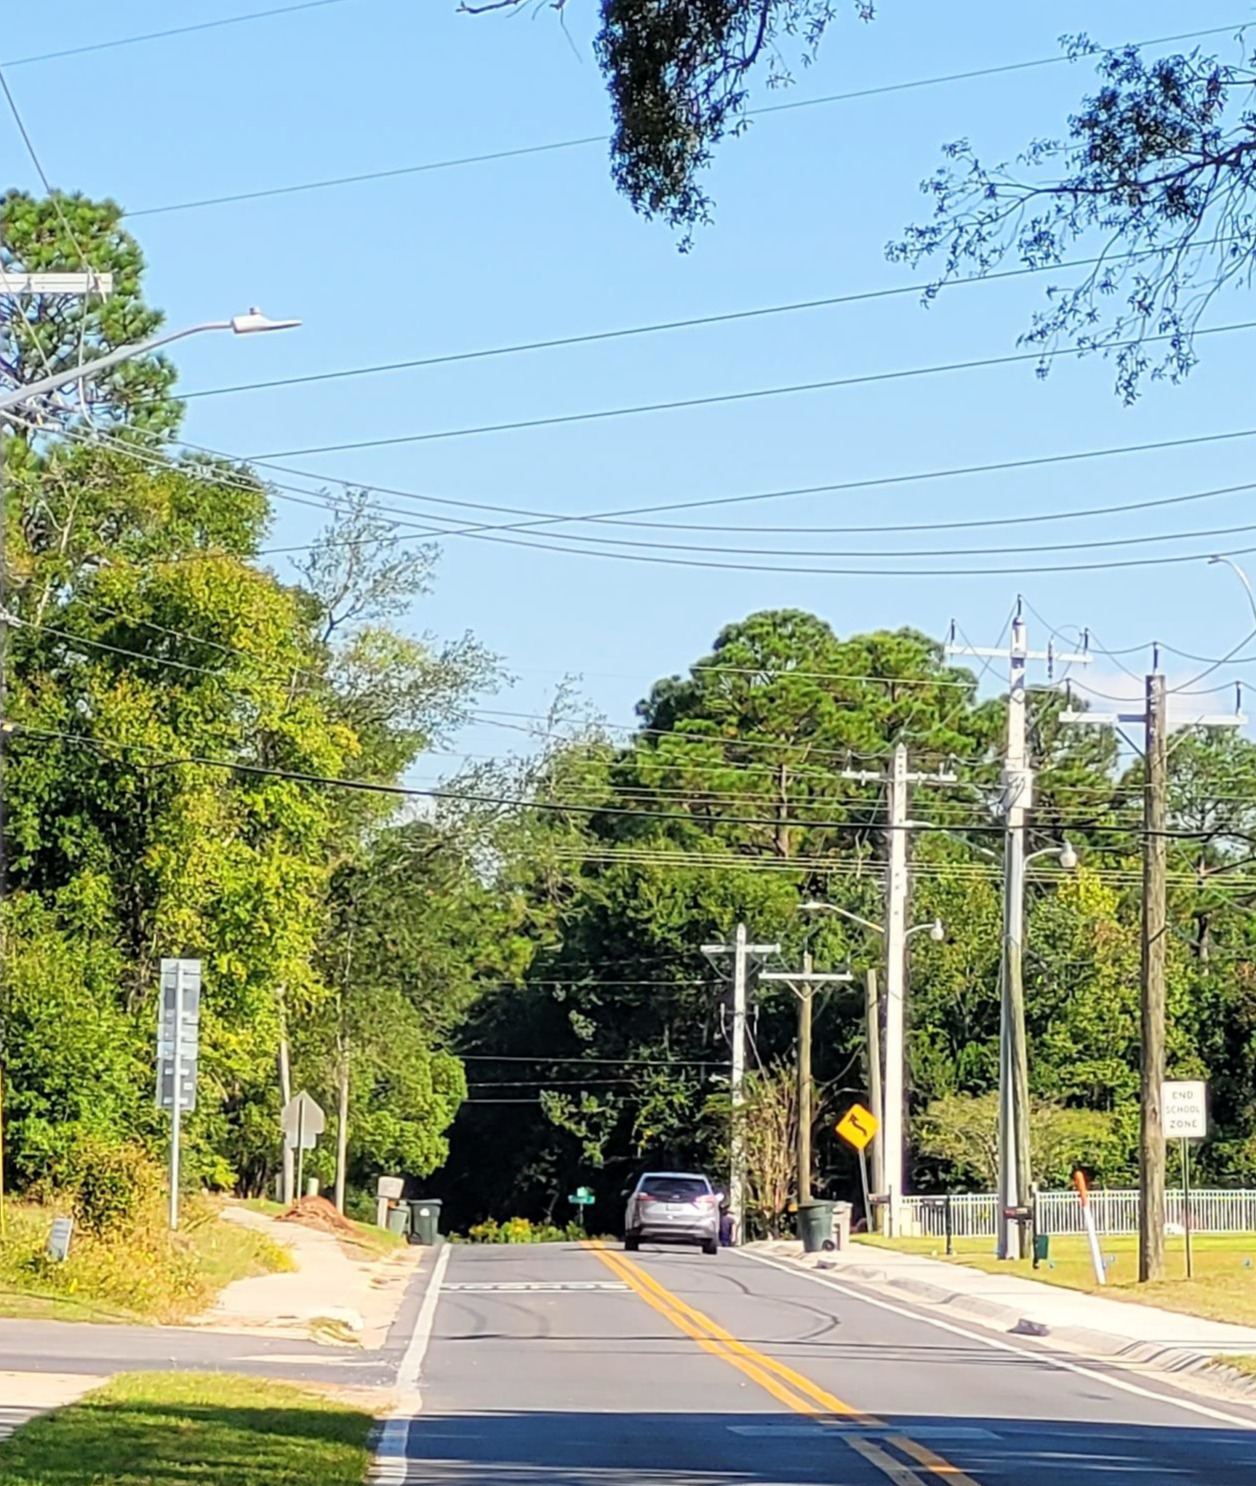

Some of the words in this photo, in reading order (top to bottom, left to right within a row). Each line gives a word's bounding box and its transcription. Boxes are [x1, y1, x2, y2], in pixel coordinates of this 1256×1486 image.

[1172, 1090, 1194, 1100] END
[1166, 1105, 1200, 1114] SCHOOL
[1169, 1119, 1198, 1129] ZONE
